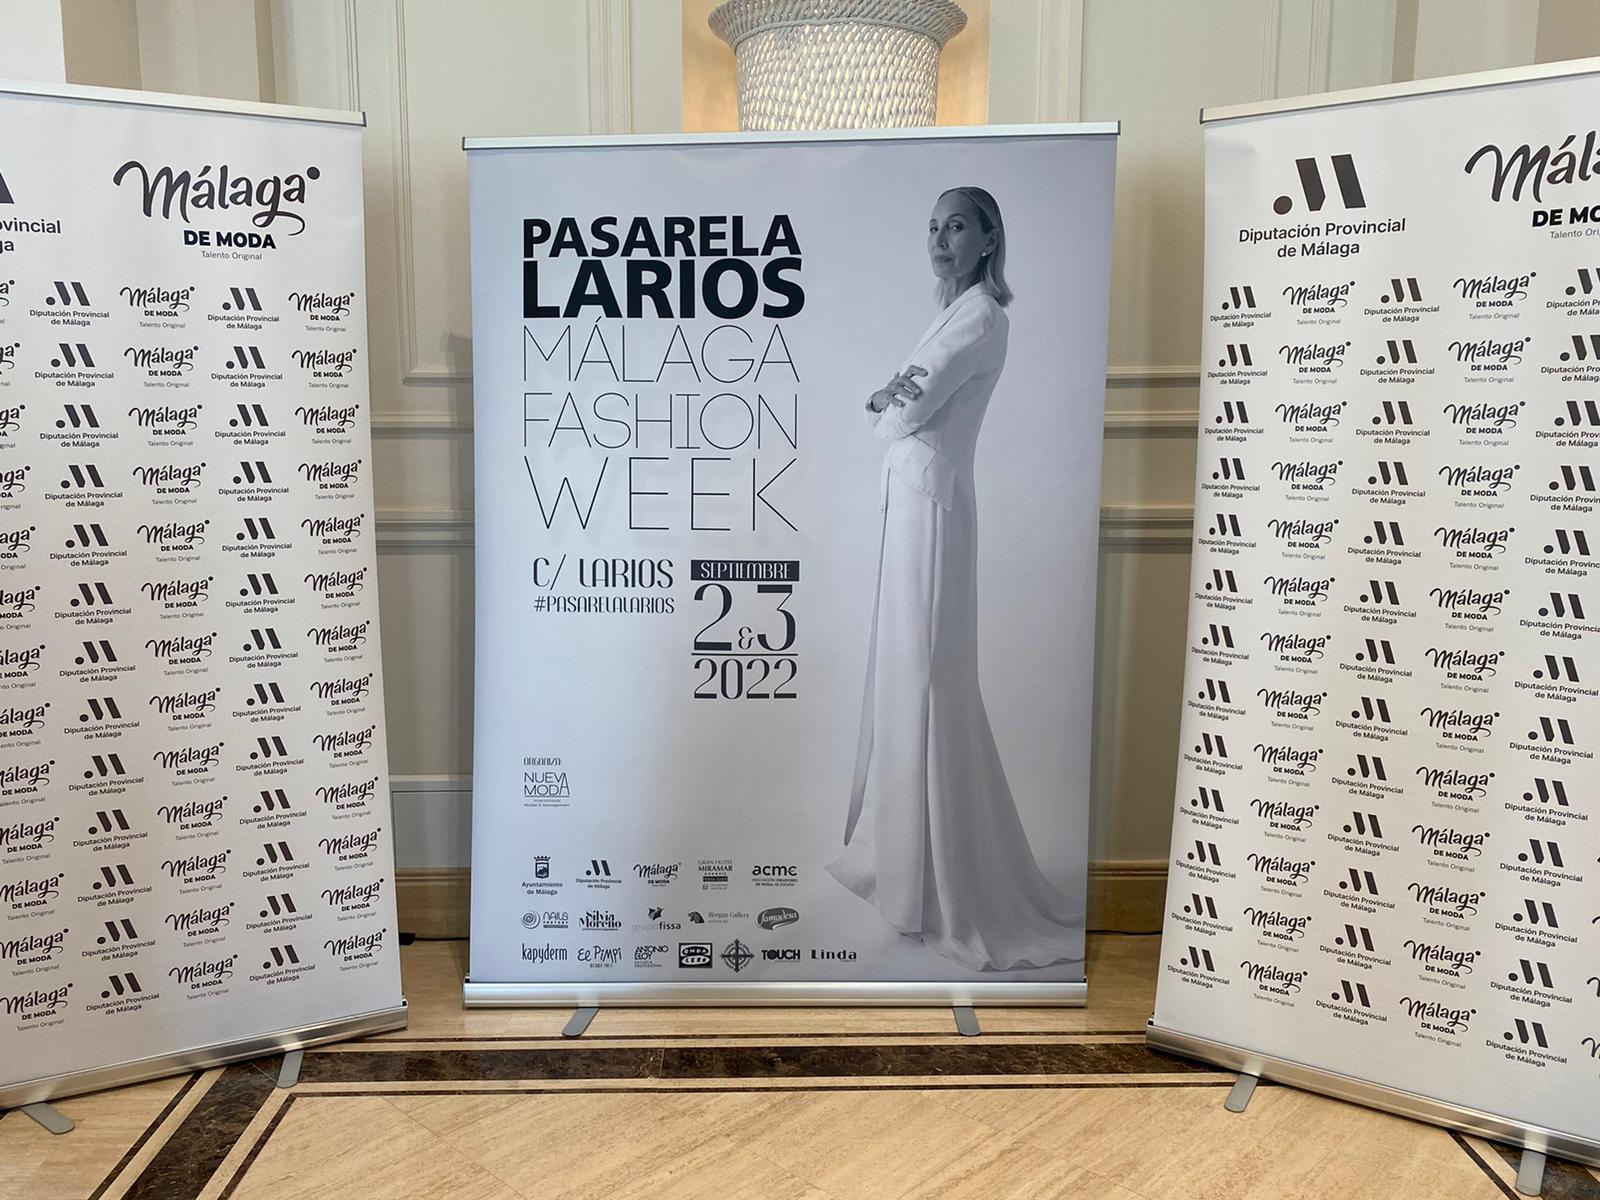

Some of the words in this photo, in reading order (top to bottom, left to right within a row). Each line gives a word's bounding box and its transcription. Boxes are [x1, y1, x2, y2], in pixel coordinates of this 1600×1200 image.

[113, 161, 305, 236] Málaga
[0, 217, 61, 234] vincial
[1532, 209, 1563, 227] DE
[184, 230, 210, 246] DE
[216, 232, 276, 249] MODA
[523, 214, 802, 258] PASARELA
[1239, 224, 1320, 244] Diputación
[1326, 218, 1406, 236] Provincial
[1550, 230, 1582, 239] Talento
[201, 251, 230, 259] Talento
[232, 252, 262, 261] Original
[1277, 245, 1296, 258] de
[1301, 242, 1360, 257] Málaga
[523, 258, 805, 319] LARIOS
[1453, 275, 1530, 301] Málaga
[120, 287, 190, 312] Málaga
[30, 310, 71, 318] Diputación
[73, 310, 110, 318] Provincial
[1364, 307, 1403, 316] Diputación
[1393, 313, 1420, 322] Málaga
[63, 318, 90, 327] Málaga
[523, 316, 800, 383] MÁLAGA
[524, 392, 797, 450] FASHION
[1443, 403, 1519, 430] Málaga
[1356, 429, 1394, 437] Diputación
[1385, 437, 1410, 446] Málaga
[524, 456, 798, 531] WEEK
[301, 516, 361, 537] Málaga
[1268, 519, 1333, 544] Málaga
[251, 551, 275, 559] Málaga
[1348, 547, 1385, 556] Diputación
[1386, 550, 1421, 558] Provincial
[1376, 557, 1402, 565] Málaga
[532, 554, 566, 591] C/
[580, 558, 674, 588] LARIOS
[700, 562, 790, 579] SEPTIEMBRE
[534, 596, 675, 614] #PASARELALARIOS
[694, 658, 797, 699] 2022
[153, 746, 219, 768] Málaga
[69, 780, 108, 791] Diputación
[109, 777, 144, 786] Provincial
[100, 786, 126, 795] Málaga
[1416, 767, 1489, 797] Málaga
[1450, 792, 1474, 801] MODA
[1505, 803, 1547, 815] Diputación
[1549, 809, 1588, 821] Provincial
[1537, 815, 1566, 826] Málaga
[633, 863, 679, 880] Málaga
[752, 865, 798, 877] acme
[321, 882, 380, 905] Málaga
[536, 888, 558, 896] Málaga
[246, 919, 281, 930] Diputación
[282, 914, 312, 923] Provincial
[580, 917, 622, 928] Moreno
[586, 910, 615, 921] Silvia
[274, 924, 297, 932] Málaga
[522, 943, 568, 963] kapyderm
[762, 950, 800, 960] TOUCH
[812, 950, 857, 960] Linda
[169, 958, 233, 984] Málaga
[1241, 961, 1303, 994] Málaga
[1270, 986, 1290, 996] MODA
[1316, 1000, 1352, 1014] Diputación
[1354, 1008, 1388, 1022] Provincial
[1343, 1014, 1369, 1026] Málaga
